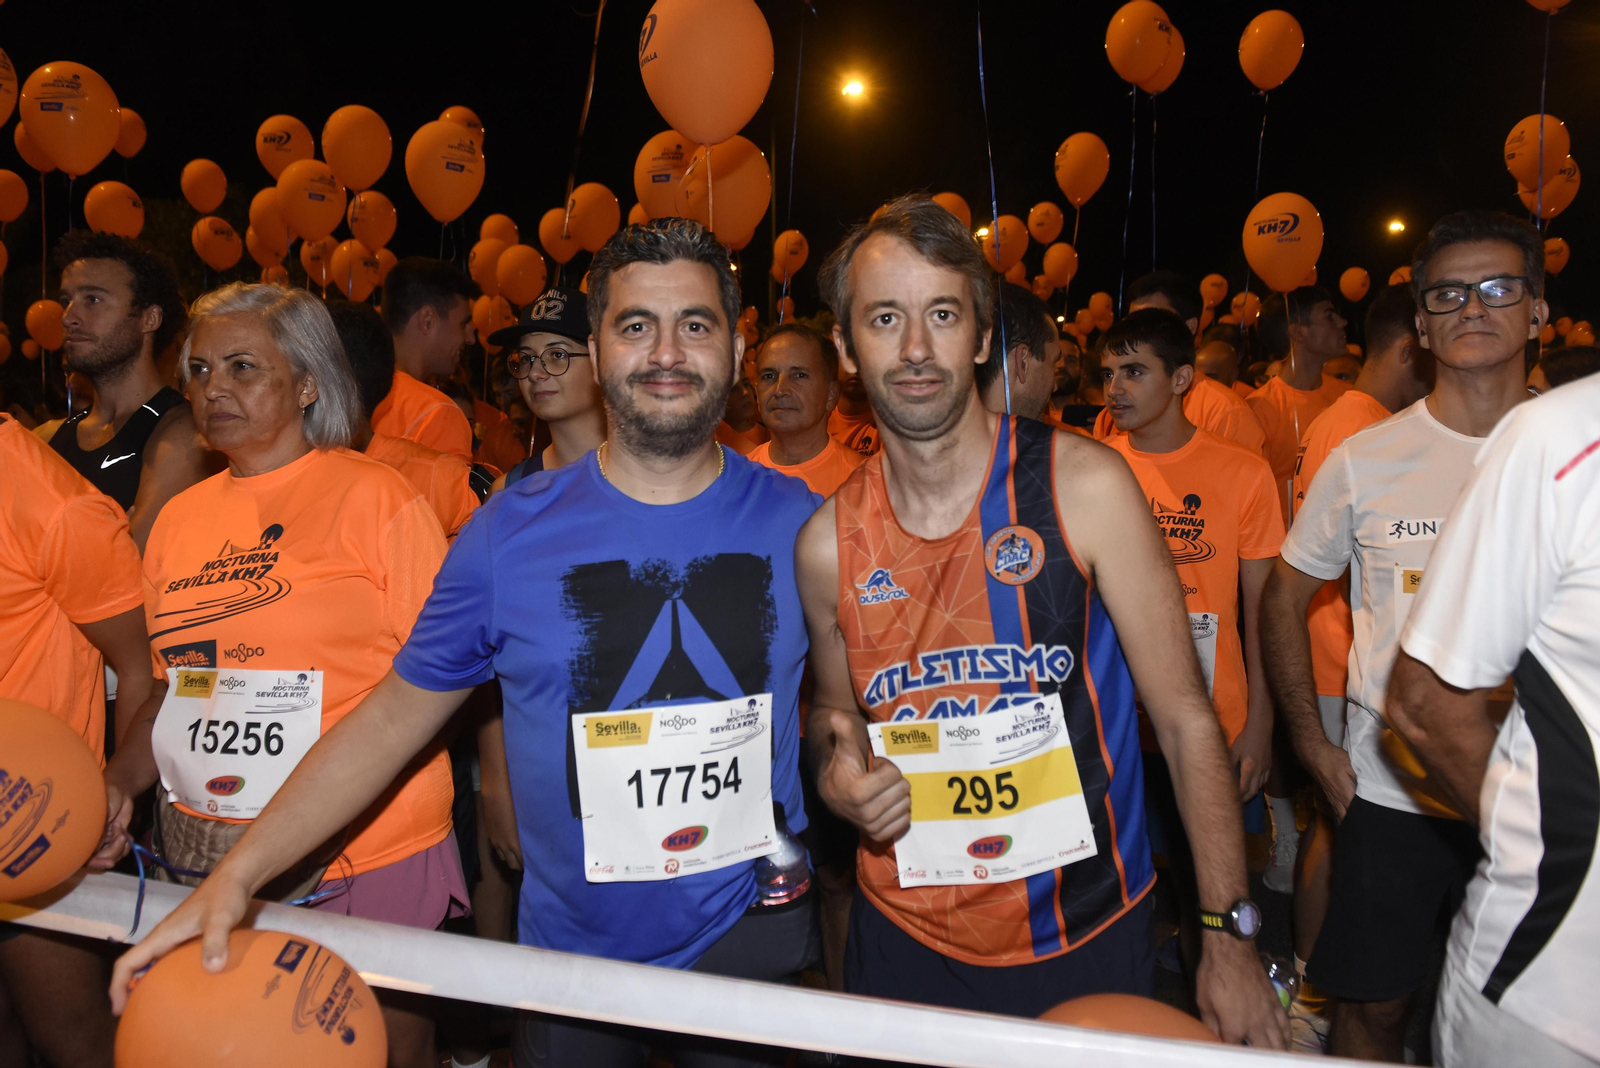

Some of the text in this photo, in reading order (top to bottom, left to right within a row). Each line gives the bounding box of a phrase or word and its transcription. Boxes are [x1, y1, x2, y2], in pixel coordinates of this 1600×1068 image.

[530, 299, 564, 321] 02
[1154, 515, 1205, 528] CTURNA
[200, 551, 279, 573] NOCTURNA
[995, 547, 1030, 571] CDAC
[164, 570, 230, 594] SEVILLA
[224, 643, 265, 663] NO8DO
[219, 676, 246, 690] NO8DO
[863, 643, 1074, 709] ATLETISMO
[660, 715, 697, 731] NO8DO
[726, 711, 759, 723] NOCTURNA
[1012, 714, 1051, 731] NOCTURNA
[187, 718, 284, 757] 15256
[709, 722, 742, 734] SEVILLA
[946, 726, 980, 741] NO8DO
[995, 728, 1031, 744] SEVILLA
[627, 756, 742, 810] 17754
[947, 770, 1019, 815] 295
